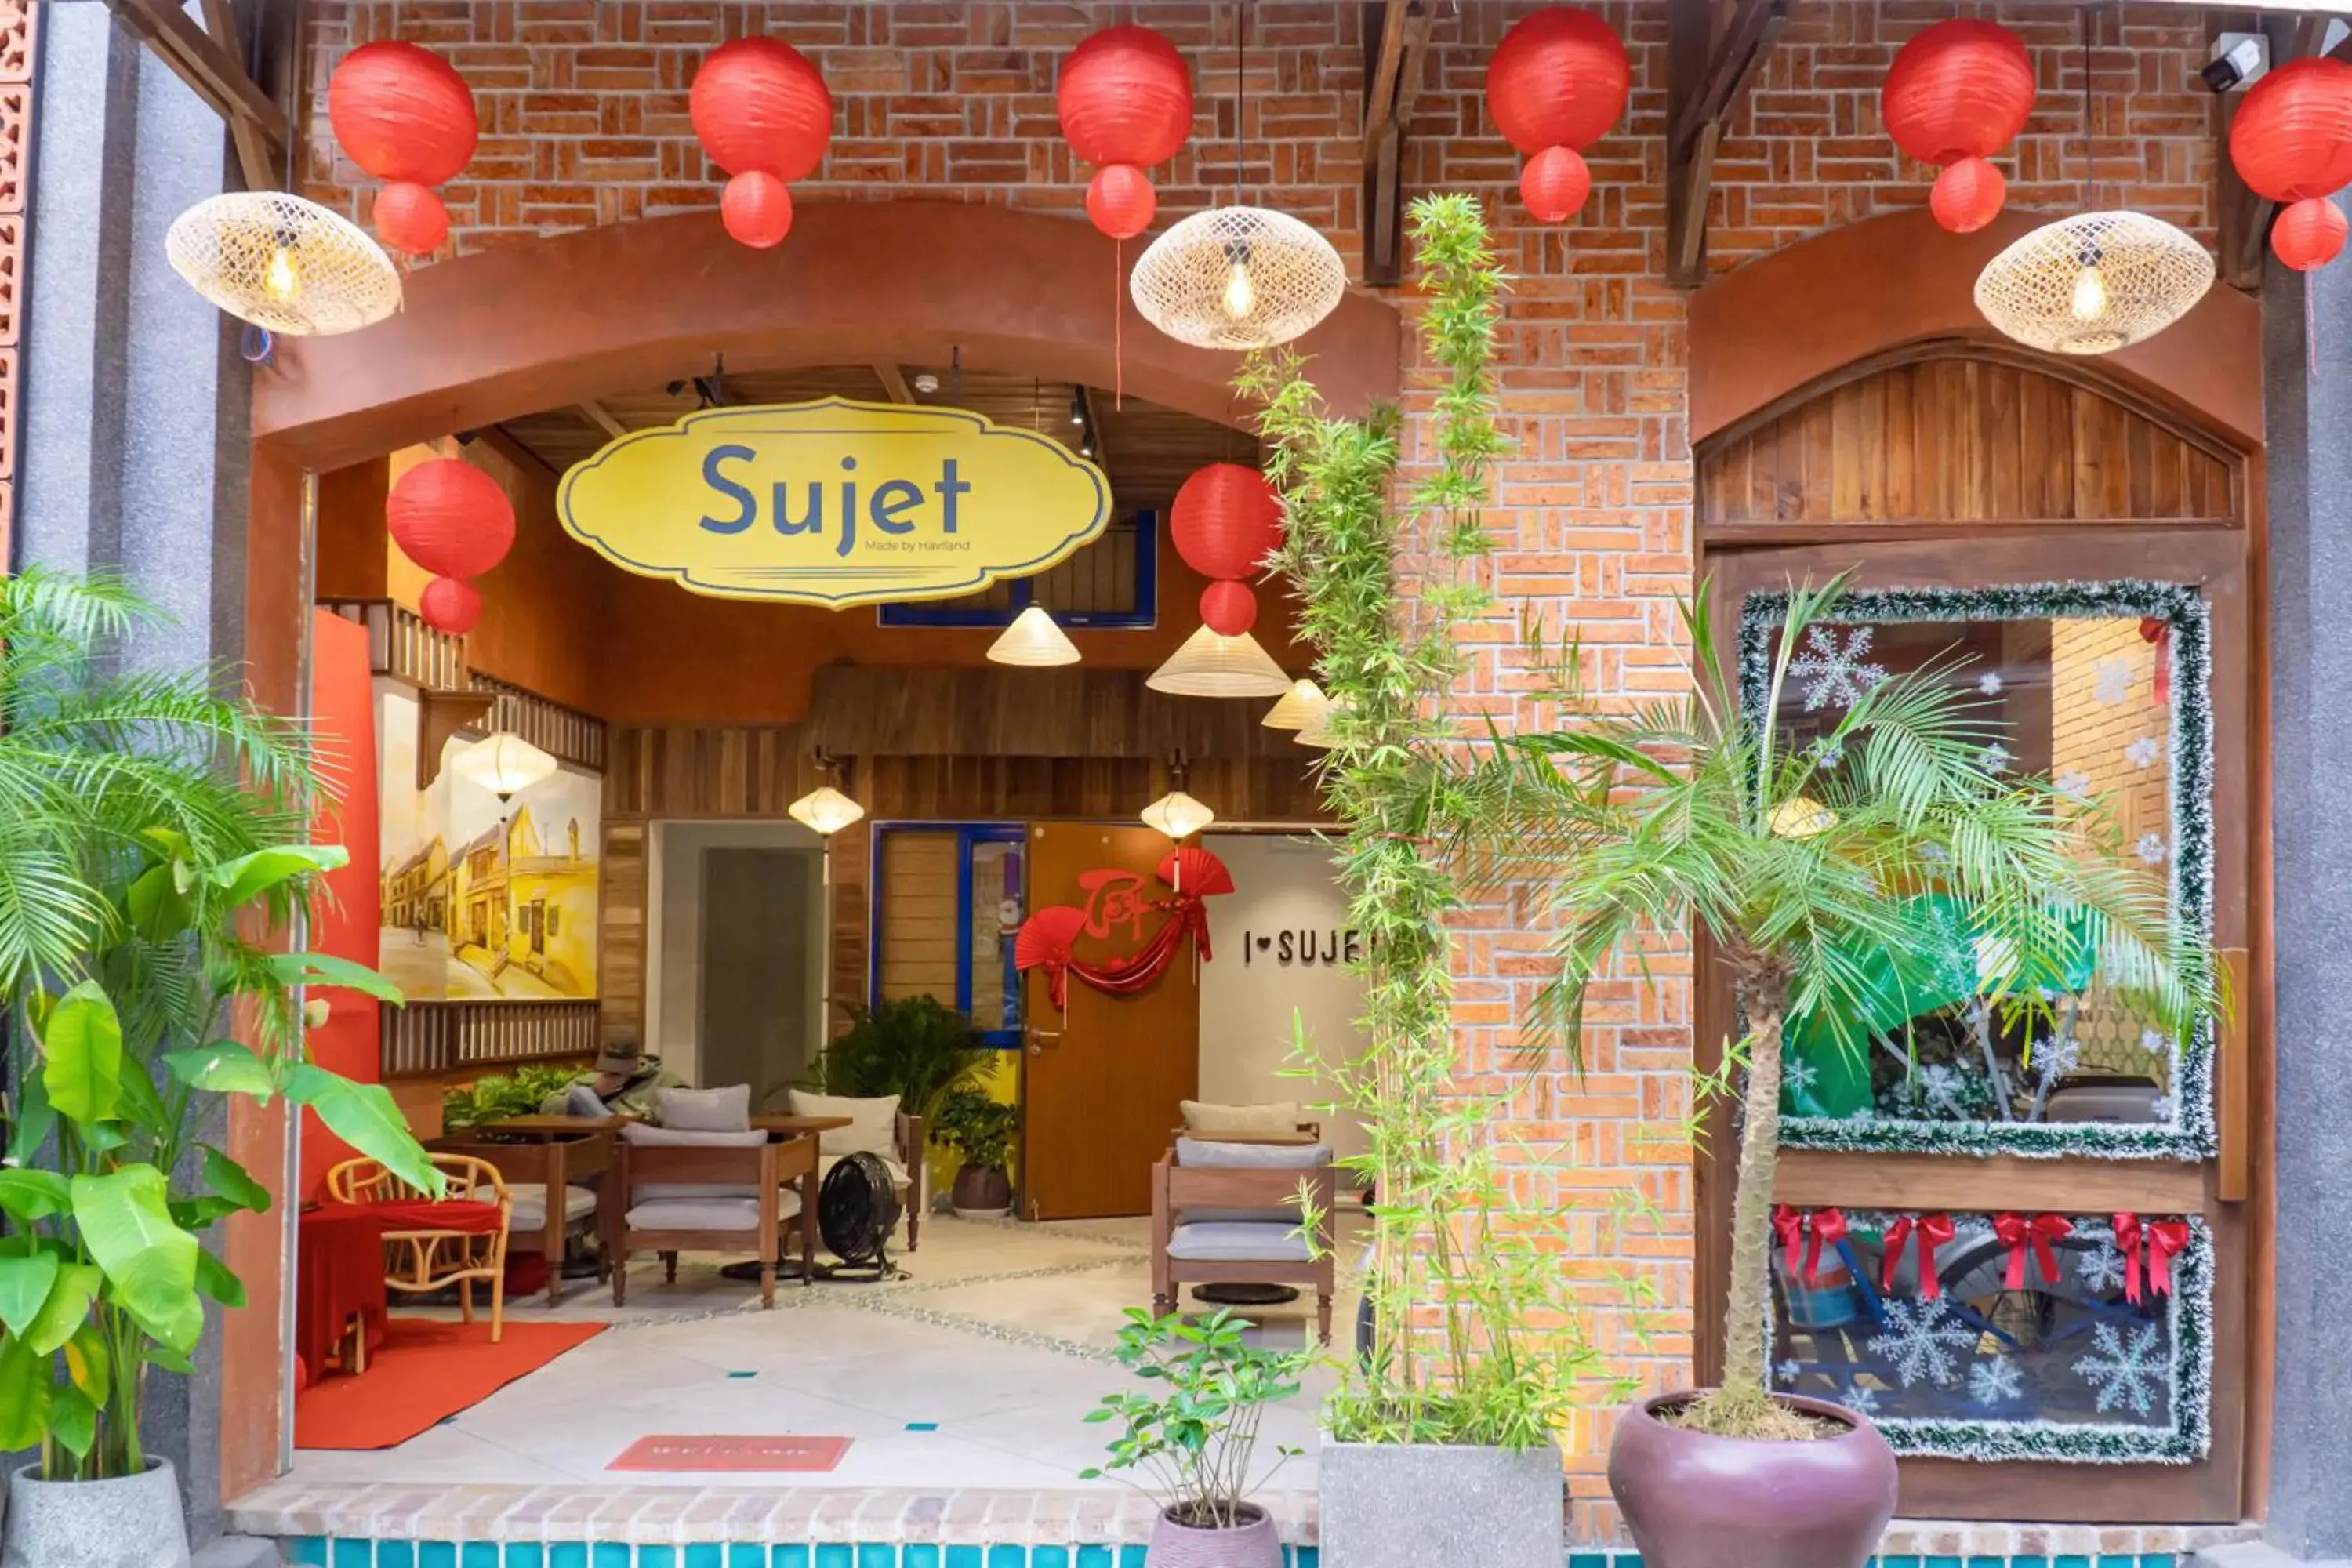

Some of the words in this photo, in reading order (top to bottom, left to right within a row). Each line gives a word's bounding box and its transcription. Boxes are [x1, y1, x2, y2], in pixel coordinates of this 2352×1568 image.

[698, 444, 971, 557] Sujet
[865, 541, 898, 550] Made
[901, 540, 916, 552] by
[1278, 929, 1377, 964] SUJE
